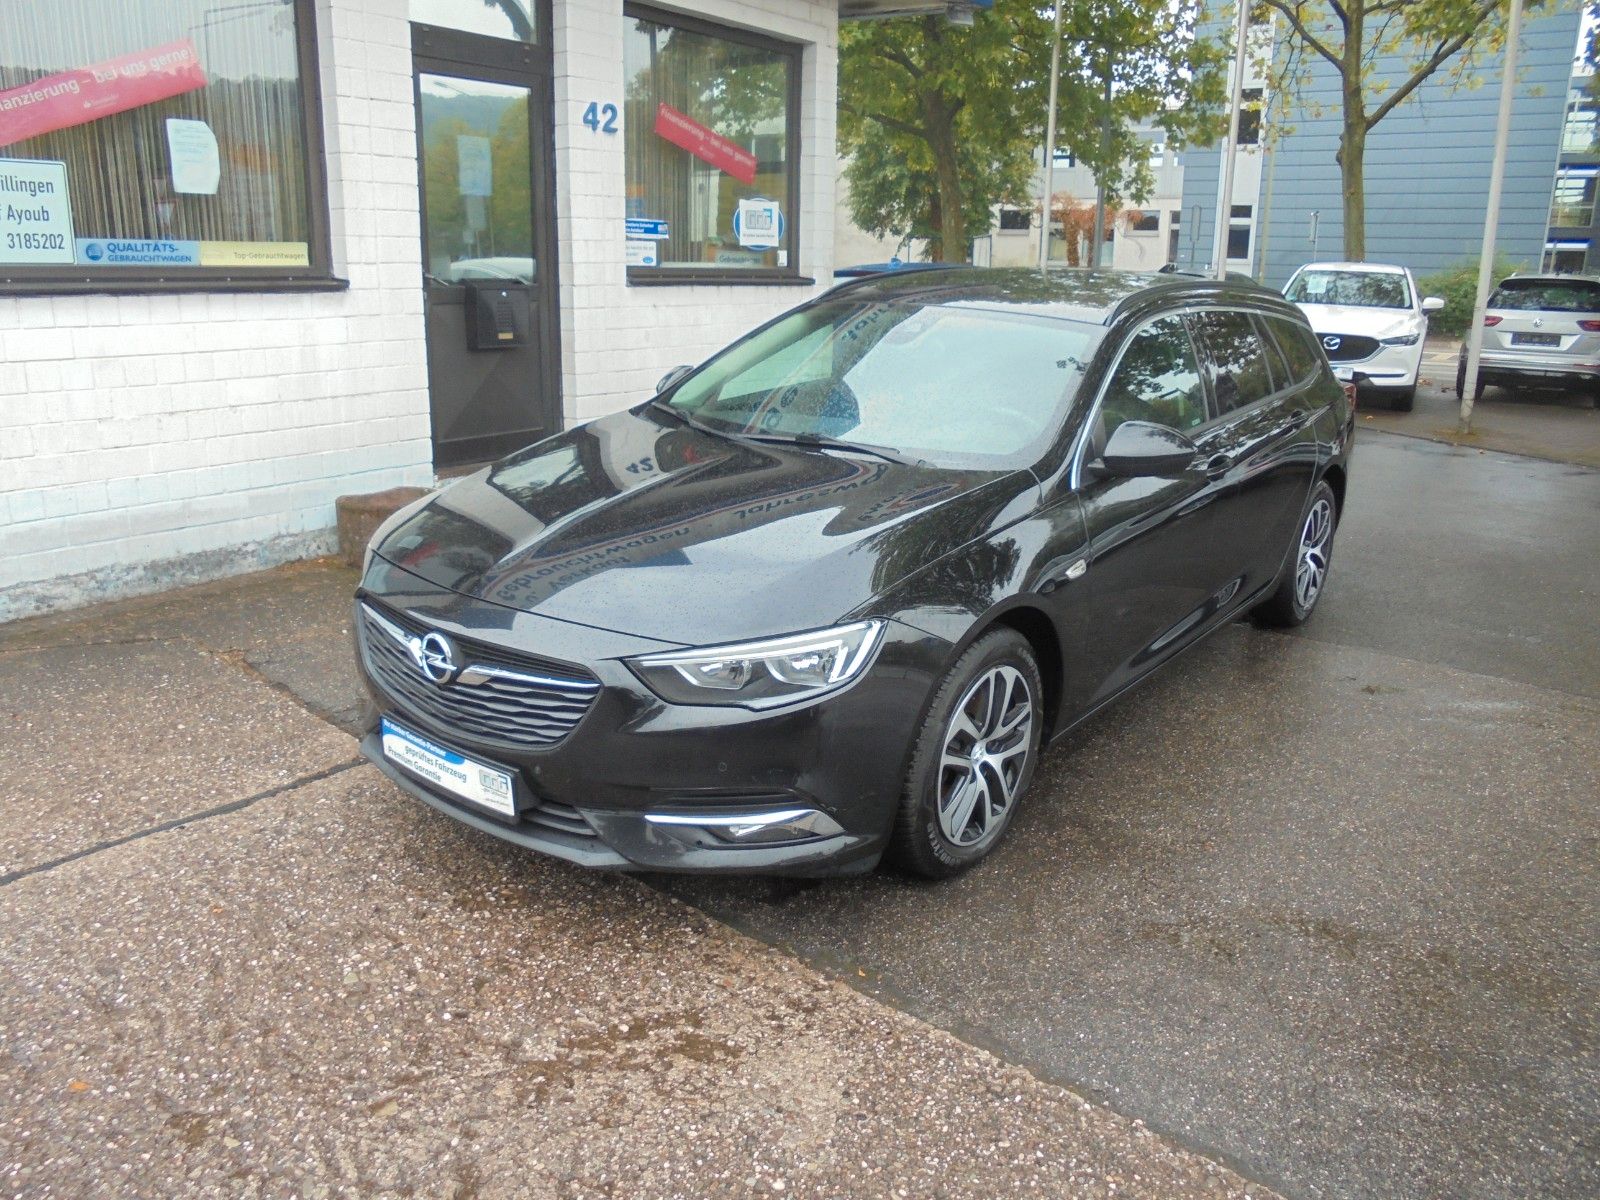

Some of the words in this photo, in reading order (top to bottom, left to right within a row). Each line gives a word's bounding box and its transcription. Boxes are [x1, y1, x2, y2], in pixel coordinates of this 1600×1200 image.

[92, 66, 118, 84] bei
[121, 63, 147, 77] uns
[582, 101, 618, 133] 42
[7, 204, 50, 225] Ayoub
[7, 232, 65, 250] 3185202
[108, 254, 192, 263] GEBRAUCHTWAGEN
[413, 761, 442, 782] Garantie
[434, 759, 467, 783] Fahrzeug
